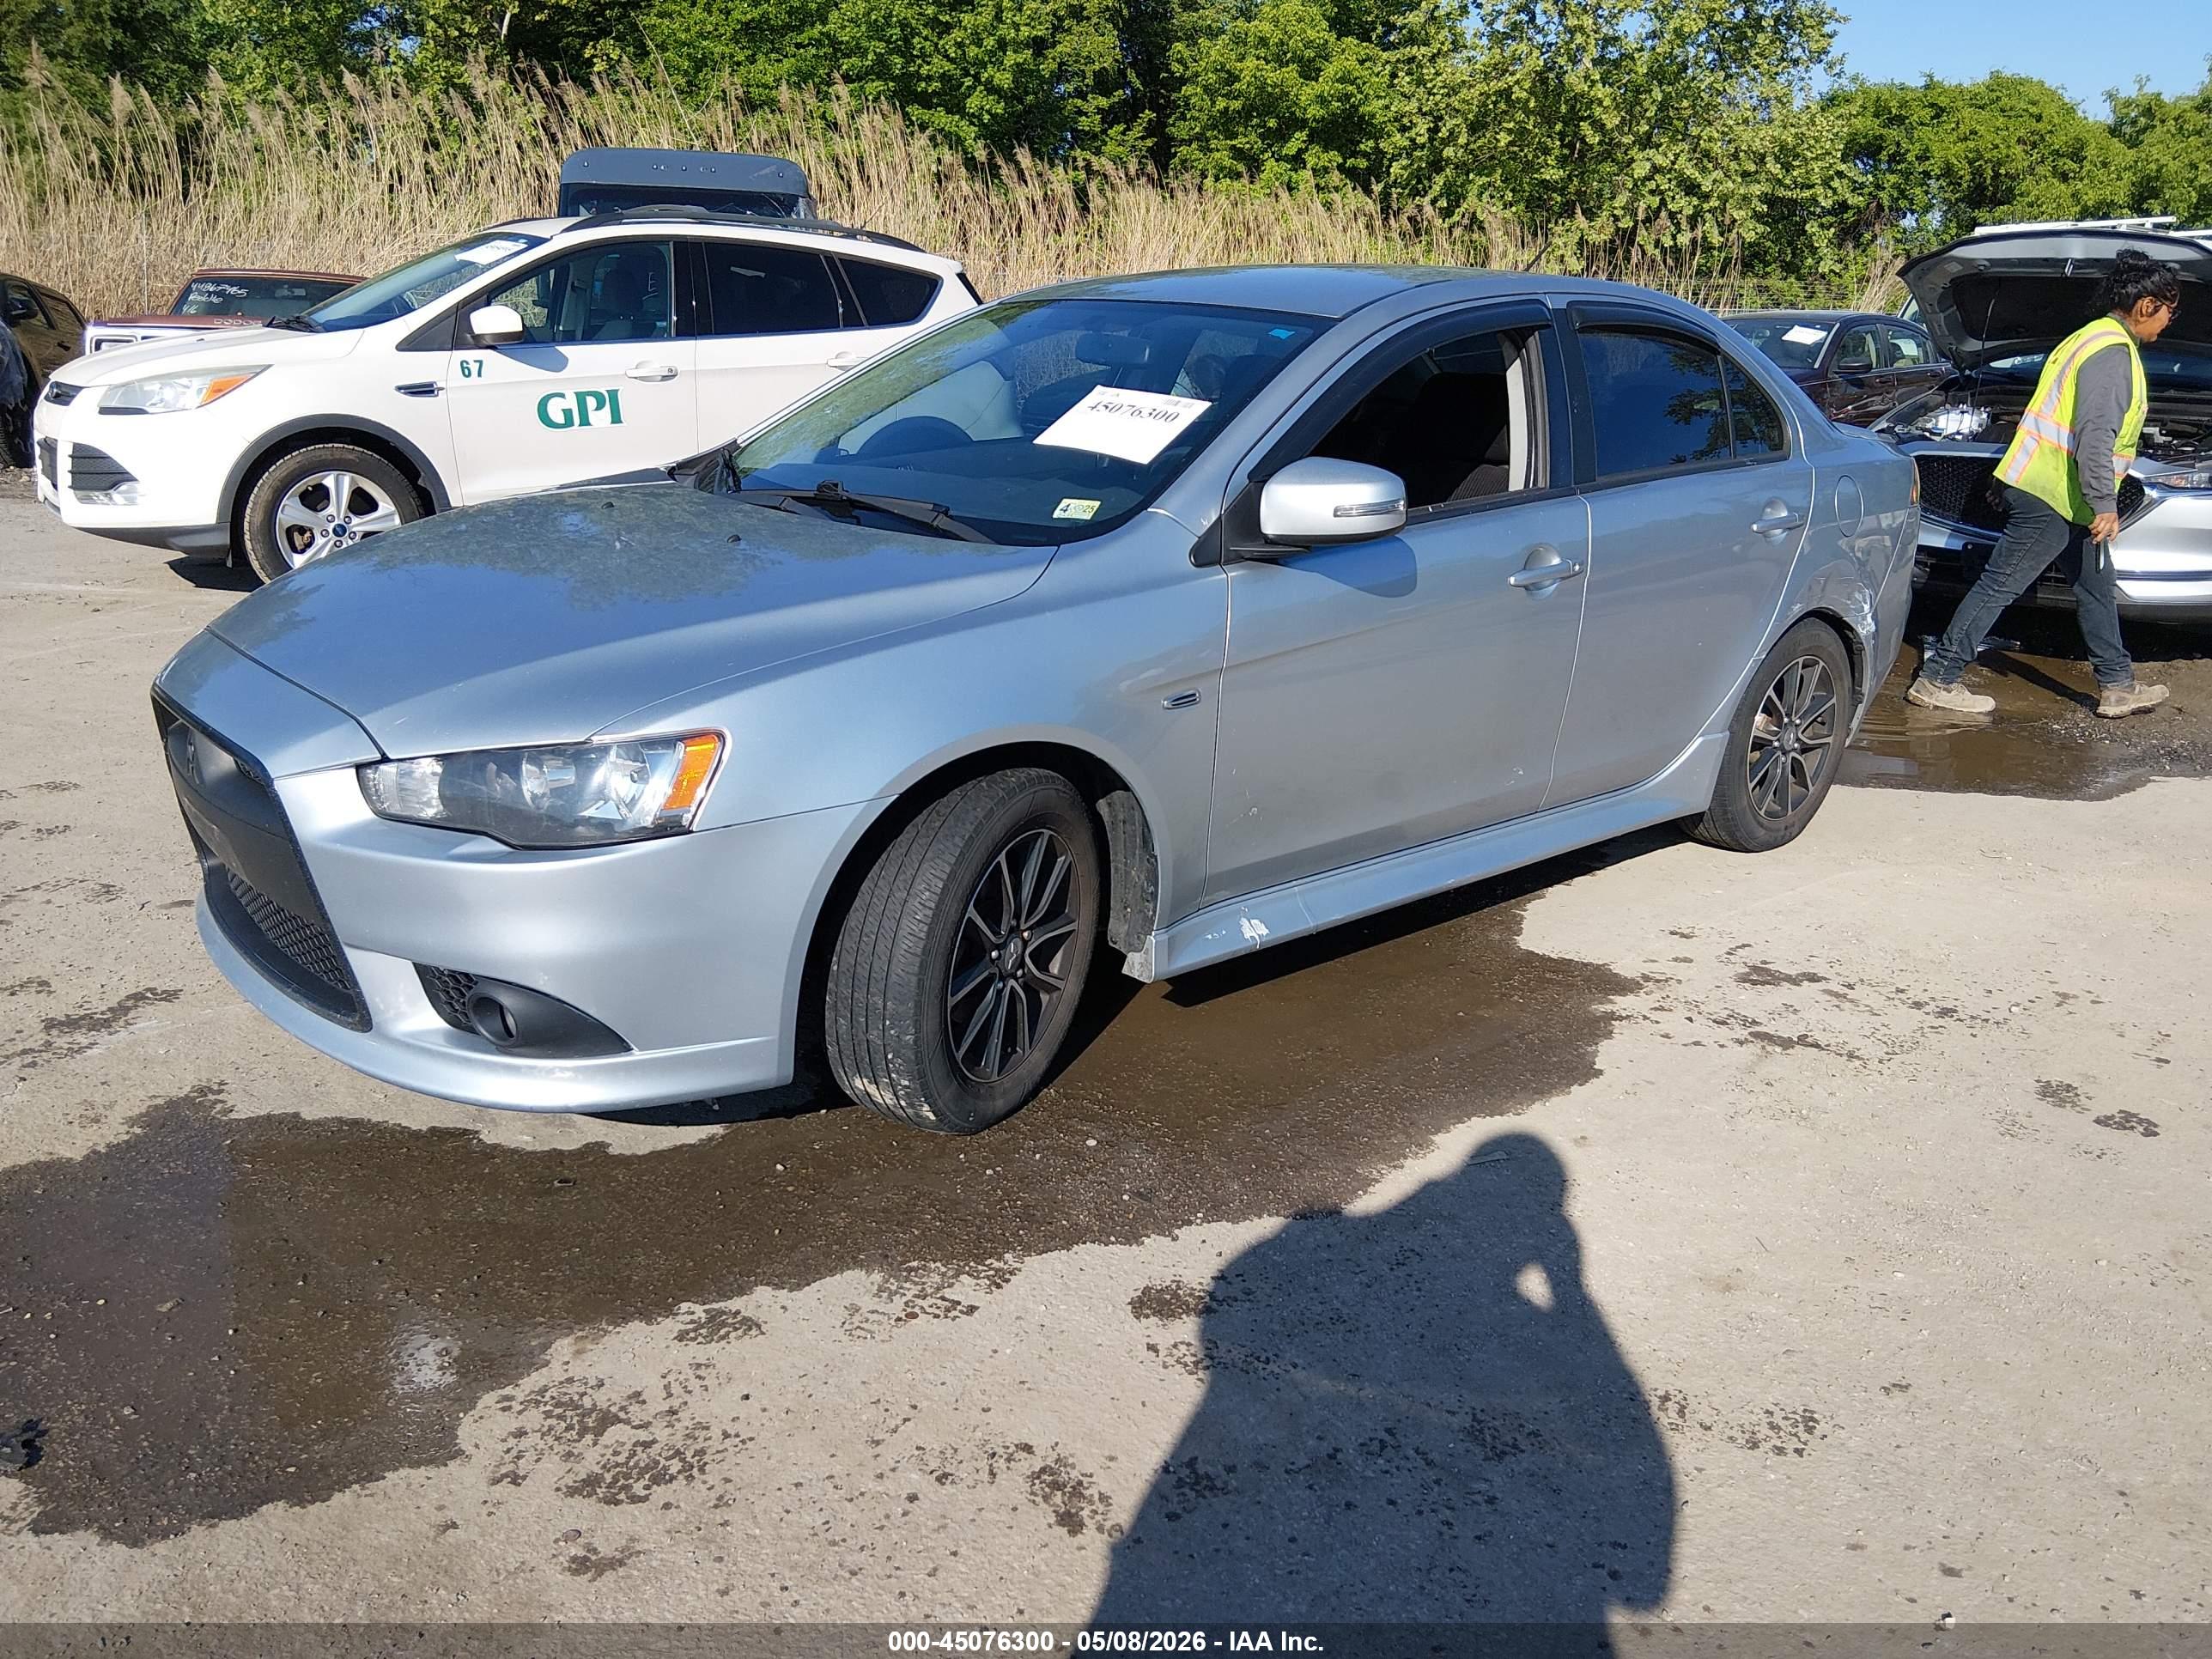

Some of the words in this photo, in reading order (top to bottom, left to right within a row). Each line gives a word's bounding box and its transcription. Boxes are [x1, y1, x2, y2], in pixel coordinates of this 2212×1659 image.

[459, 359, 484, 379] 67
[537, 388, 624, 429] GPI
[1087, 399, 1181, 423] 45076300
[1059, 502, 1071, 514] 4
[1082, 504, 1097, 514] 25
